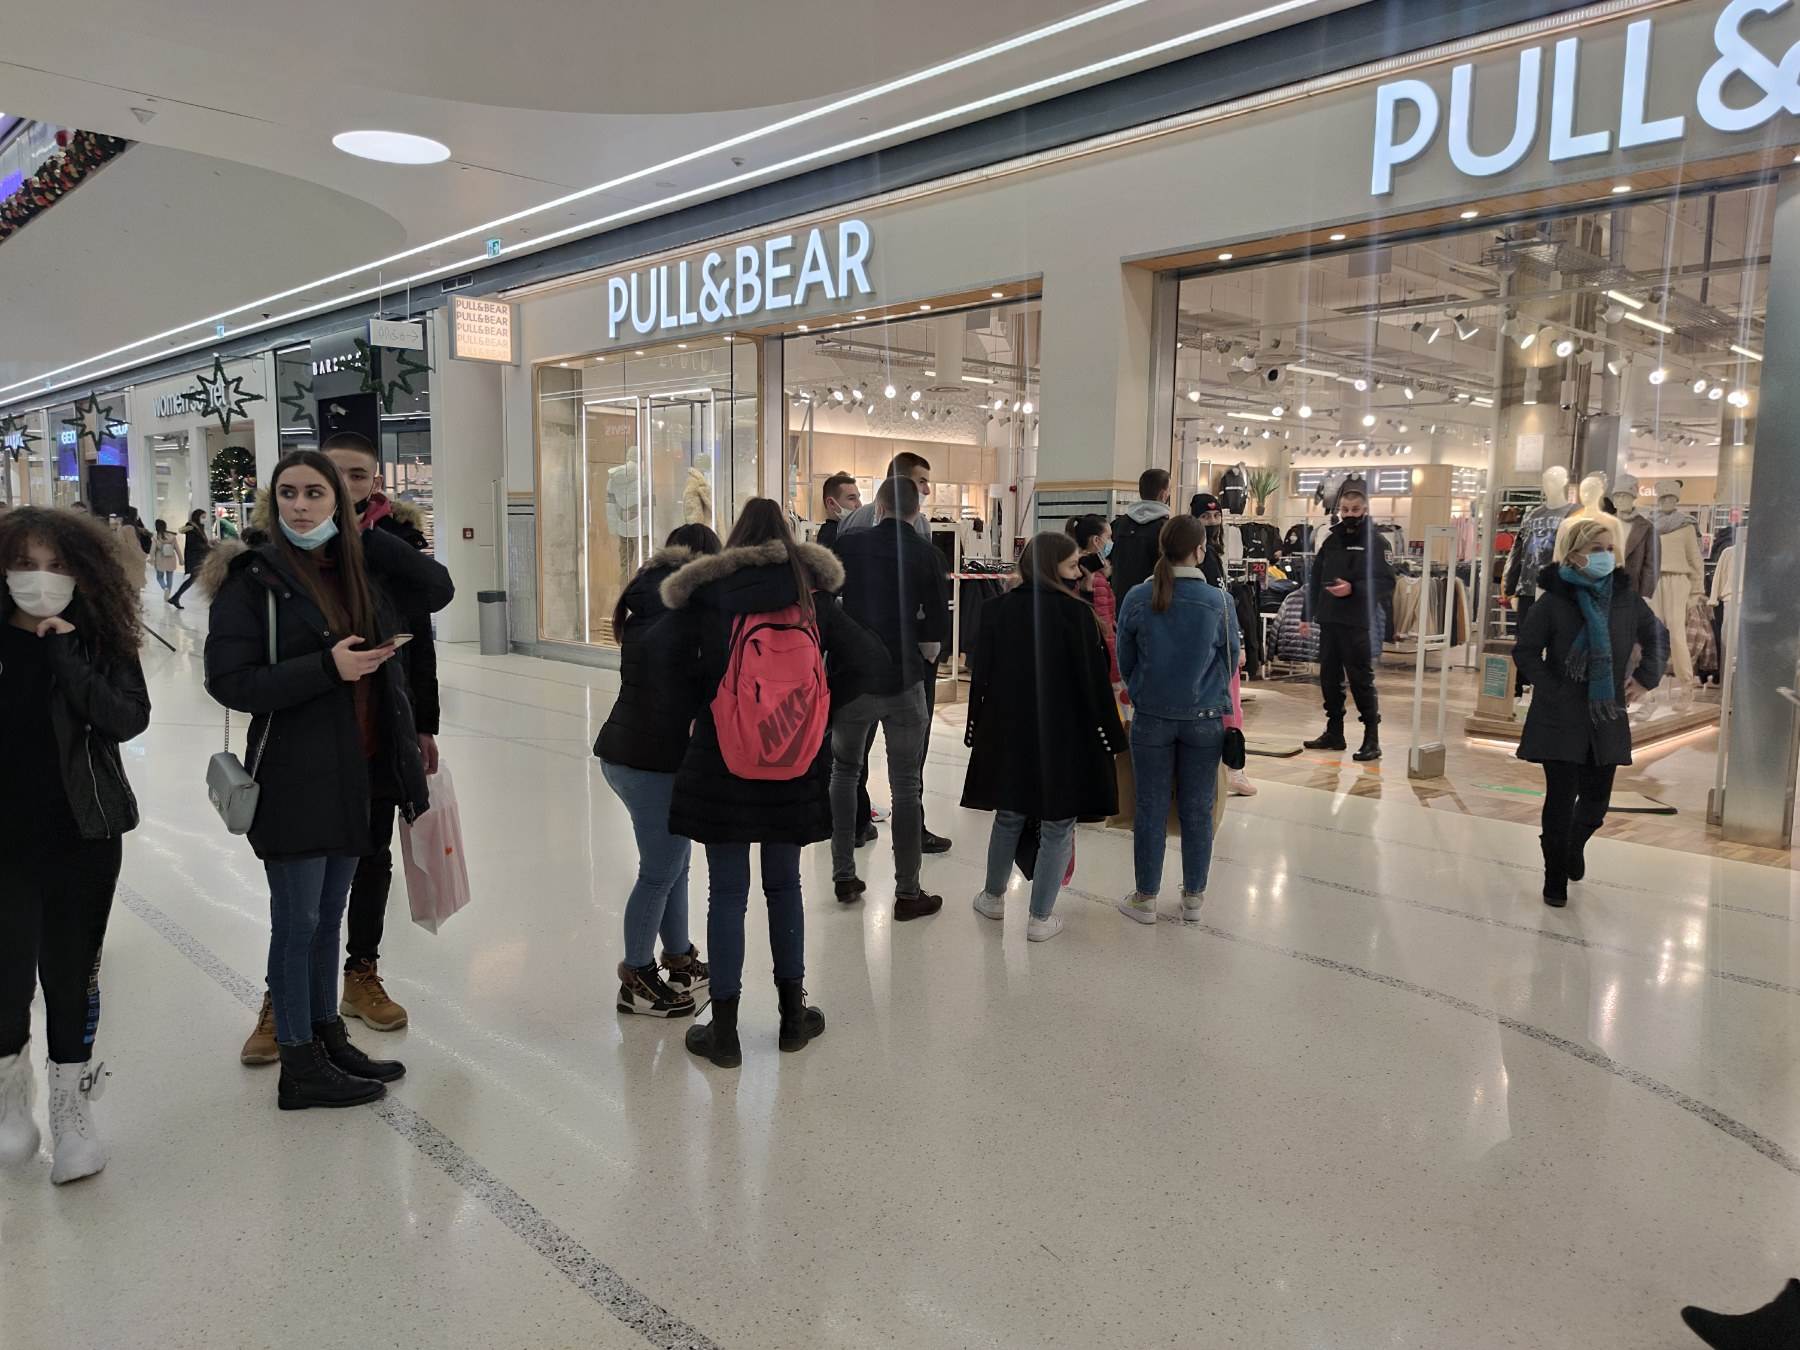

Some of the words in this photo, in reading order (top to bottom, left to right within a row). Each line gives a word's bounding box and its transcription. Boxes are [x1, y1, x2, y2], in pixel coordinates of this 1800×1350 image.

[608, 219, 873, 339] PULL&BEAR
[456, 300, 508, 315] PULL&BEAR
[456, 311, 508, 326] PULL&BEAR
[457, 322, 508, 337] PULL&BEAR
[757, 684, 811, 757] NIKE
